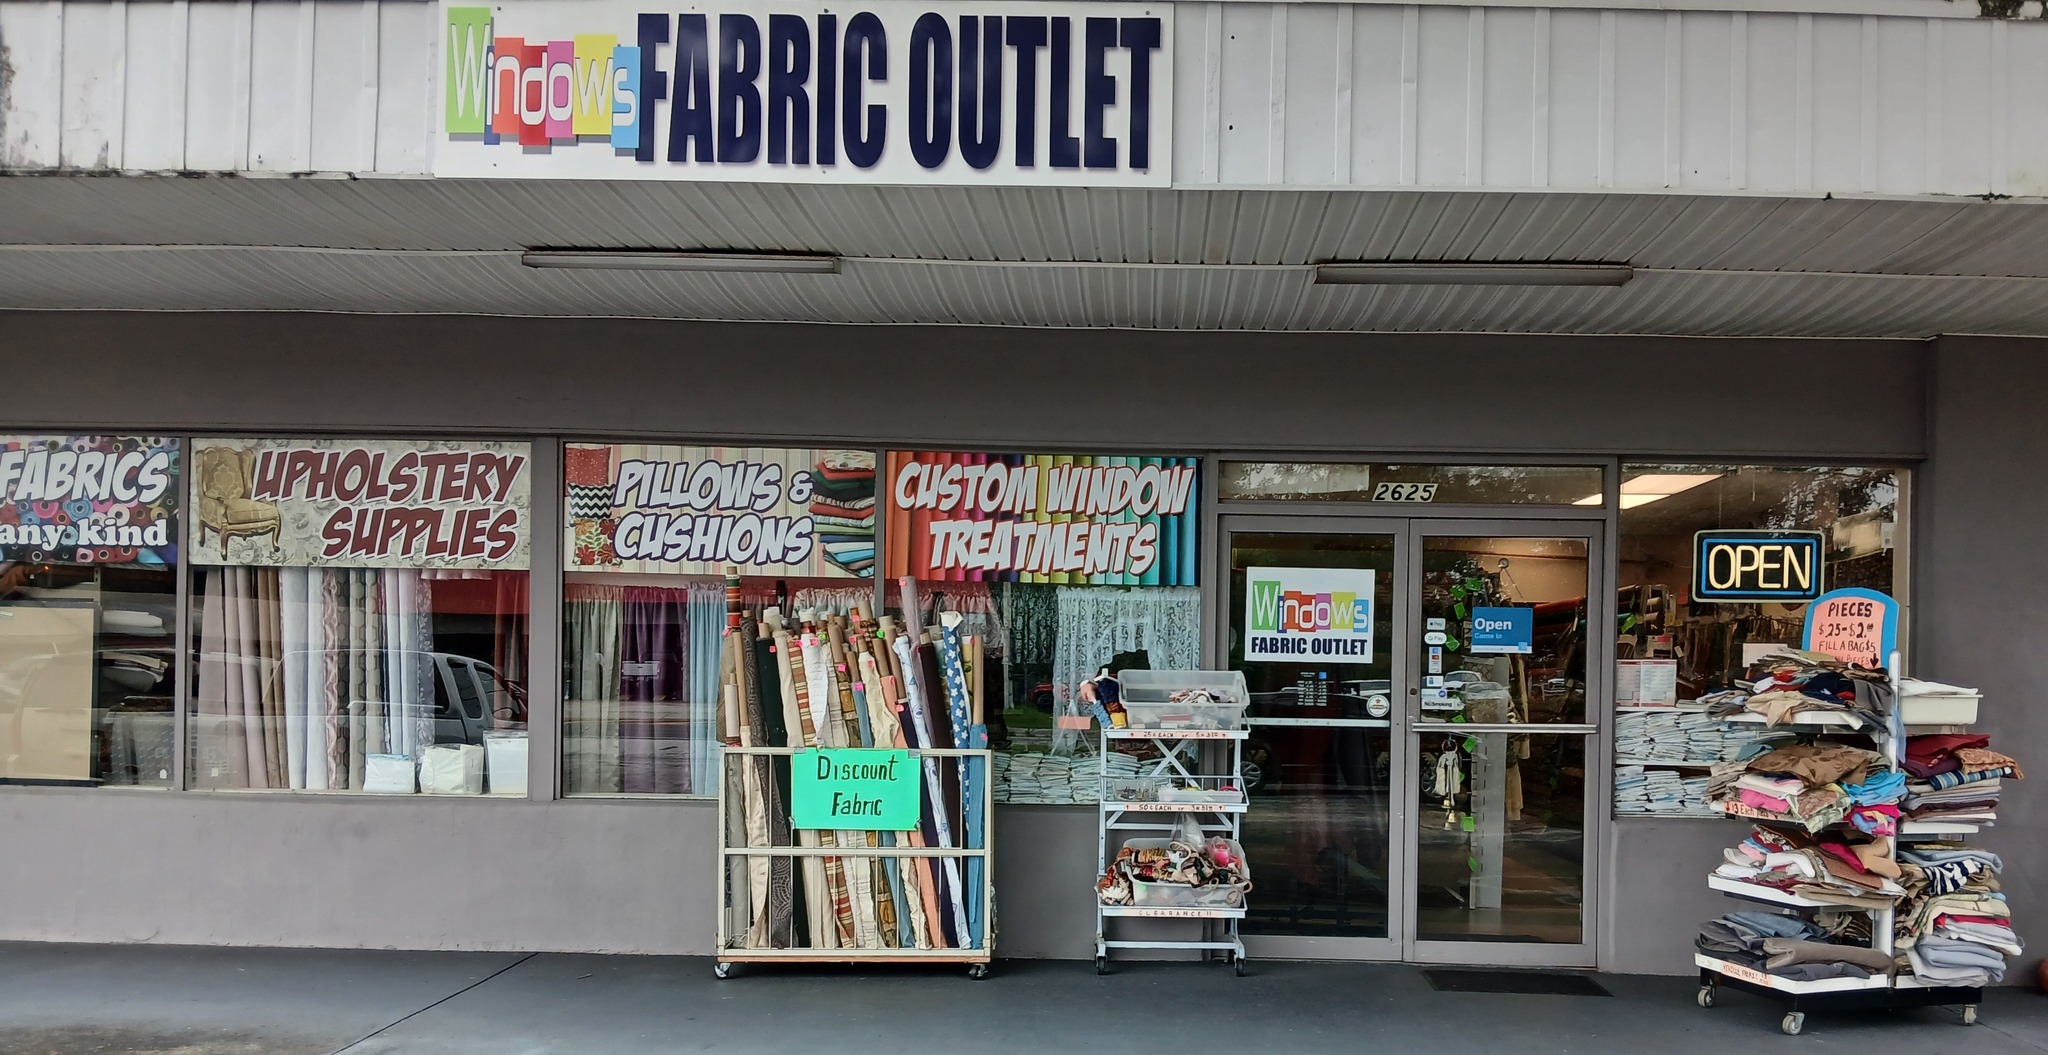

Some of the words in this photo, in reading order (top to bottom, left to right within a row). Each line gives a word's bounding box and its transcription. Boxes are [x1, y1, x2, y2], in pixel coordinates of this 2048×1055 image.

[449, 20, 638, 129] Windows
[636, 12, 889, 169] FABRIC
[908, 13, 1162, 170] OUTLET
[0, 449, 169, 503] FABRICS
[253, 448, 525, 504] UPHOLSTERY
[613, 459, 782, 512] PILLOWS
[790, 471, 813, 503] &
[897, 461, 1038, 515] CUSTOM
[1044, 464, 1195, 517] WINDOW
[1375, 483, 1435, 501] 2625
[0, 523, 66, 551] any
[77, 517, 169, 546] kind
[321, 507, 518, 560] SUPPLIES
[611, 514, 815, 566] CUSHIONS
[928, 519, 1158, 575] TREATMENTS
[1708, 544, 1812, 590] OPEN
[1253, 583, 1368, 631] Windows
[1474, 617, 1512, 633] Open
[1827, 602, 1873, 618] PIECES
[1251, 636, 1308, 655] FABRIC
[1311, 638, 1368, 656] OUTLET
[1819, 640, 1837, 652] FILL
[1840, 640, 1846, 651] A
[1847, 640, 1865, 653] BAG
[817, 752, 899, 782] Discount
[831, 792, 883, 817] Fabric
